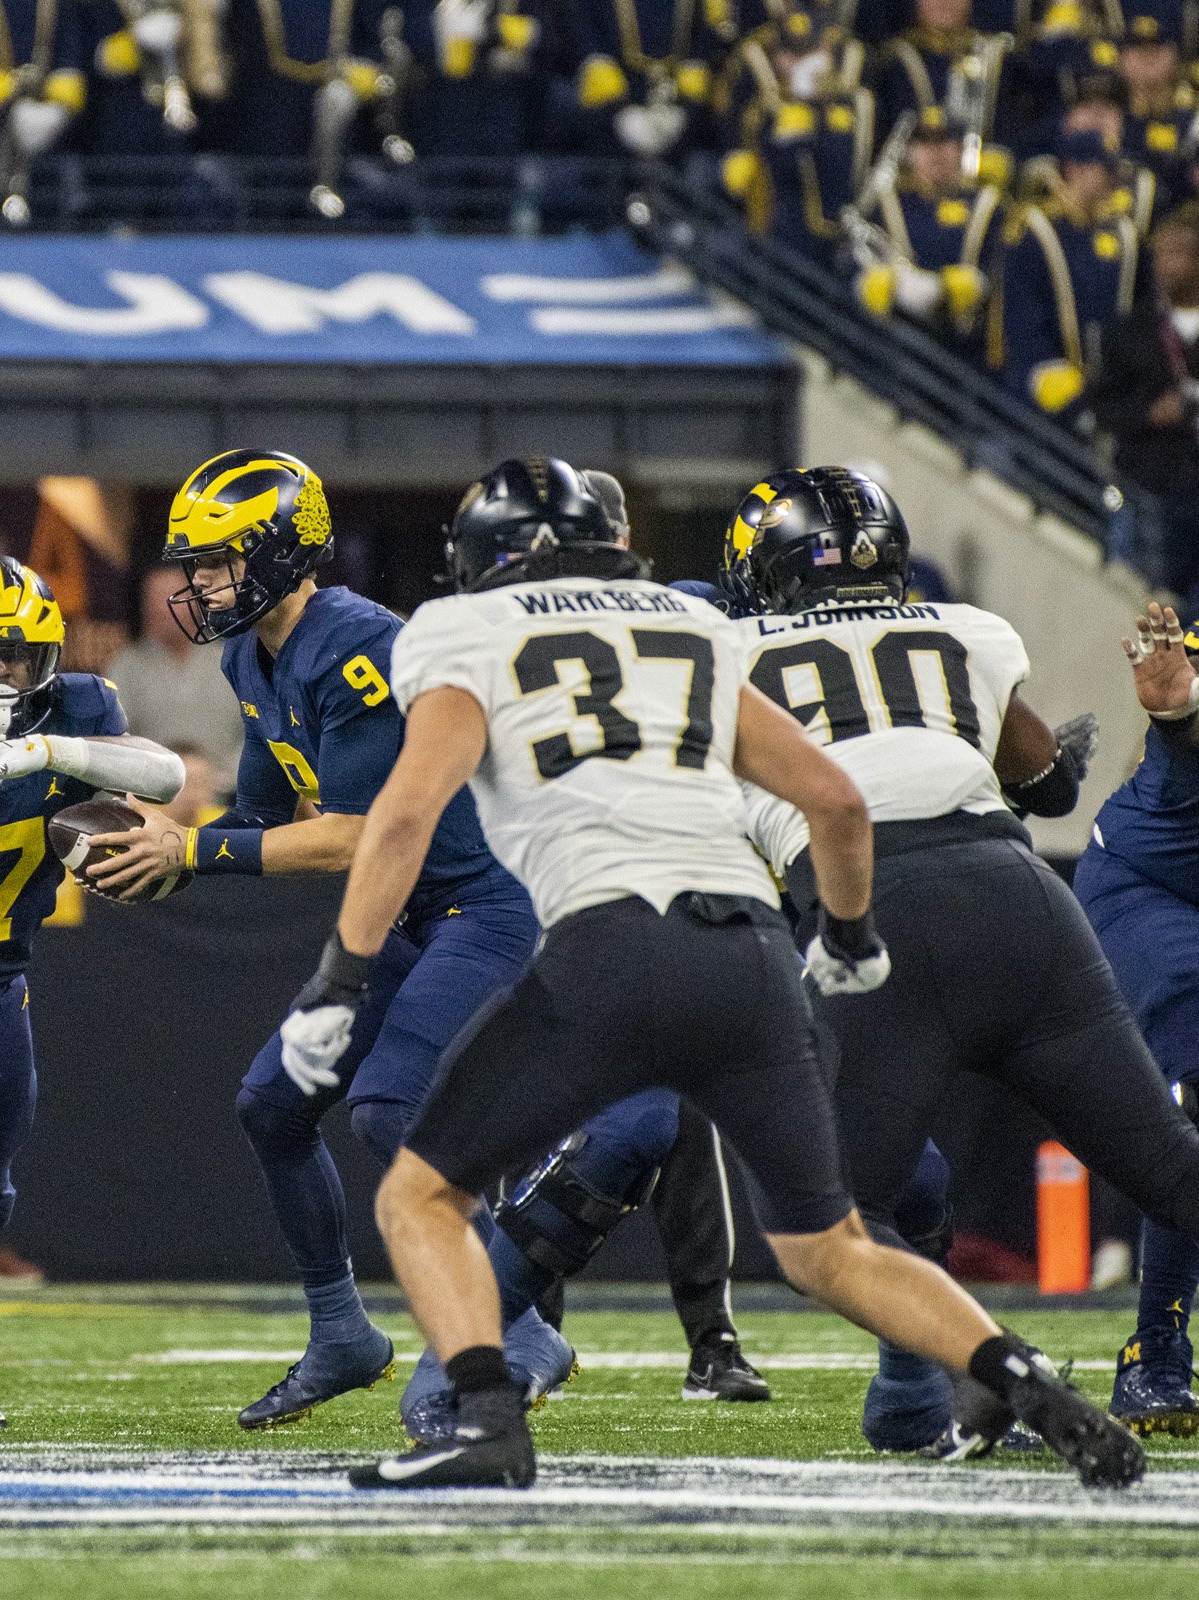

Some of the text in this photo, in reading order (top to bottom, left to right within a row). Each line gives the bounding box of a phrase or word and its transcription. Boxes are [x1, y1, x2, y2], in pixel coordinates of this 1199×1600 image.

[342, 655, 389, 706] 9
[511, 626, 716, 783] 37
[747, 628, 983, 750] 90
[1124, 1342, 1141, 1364] M
